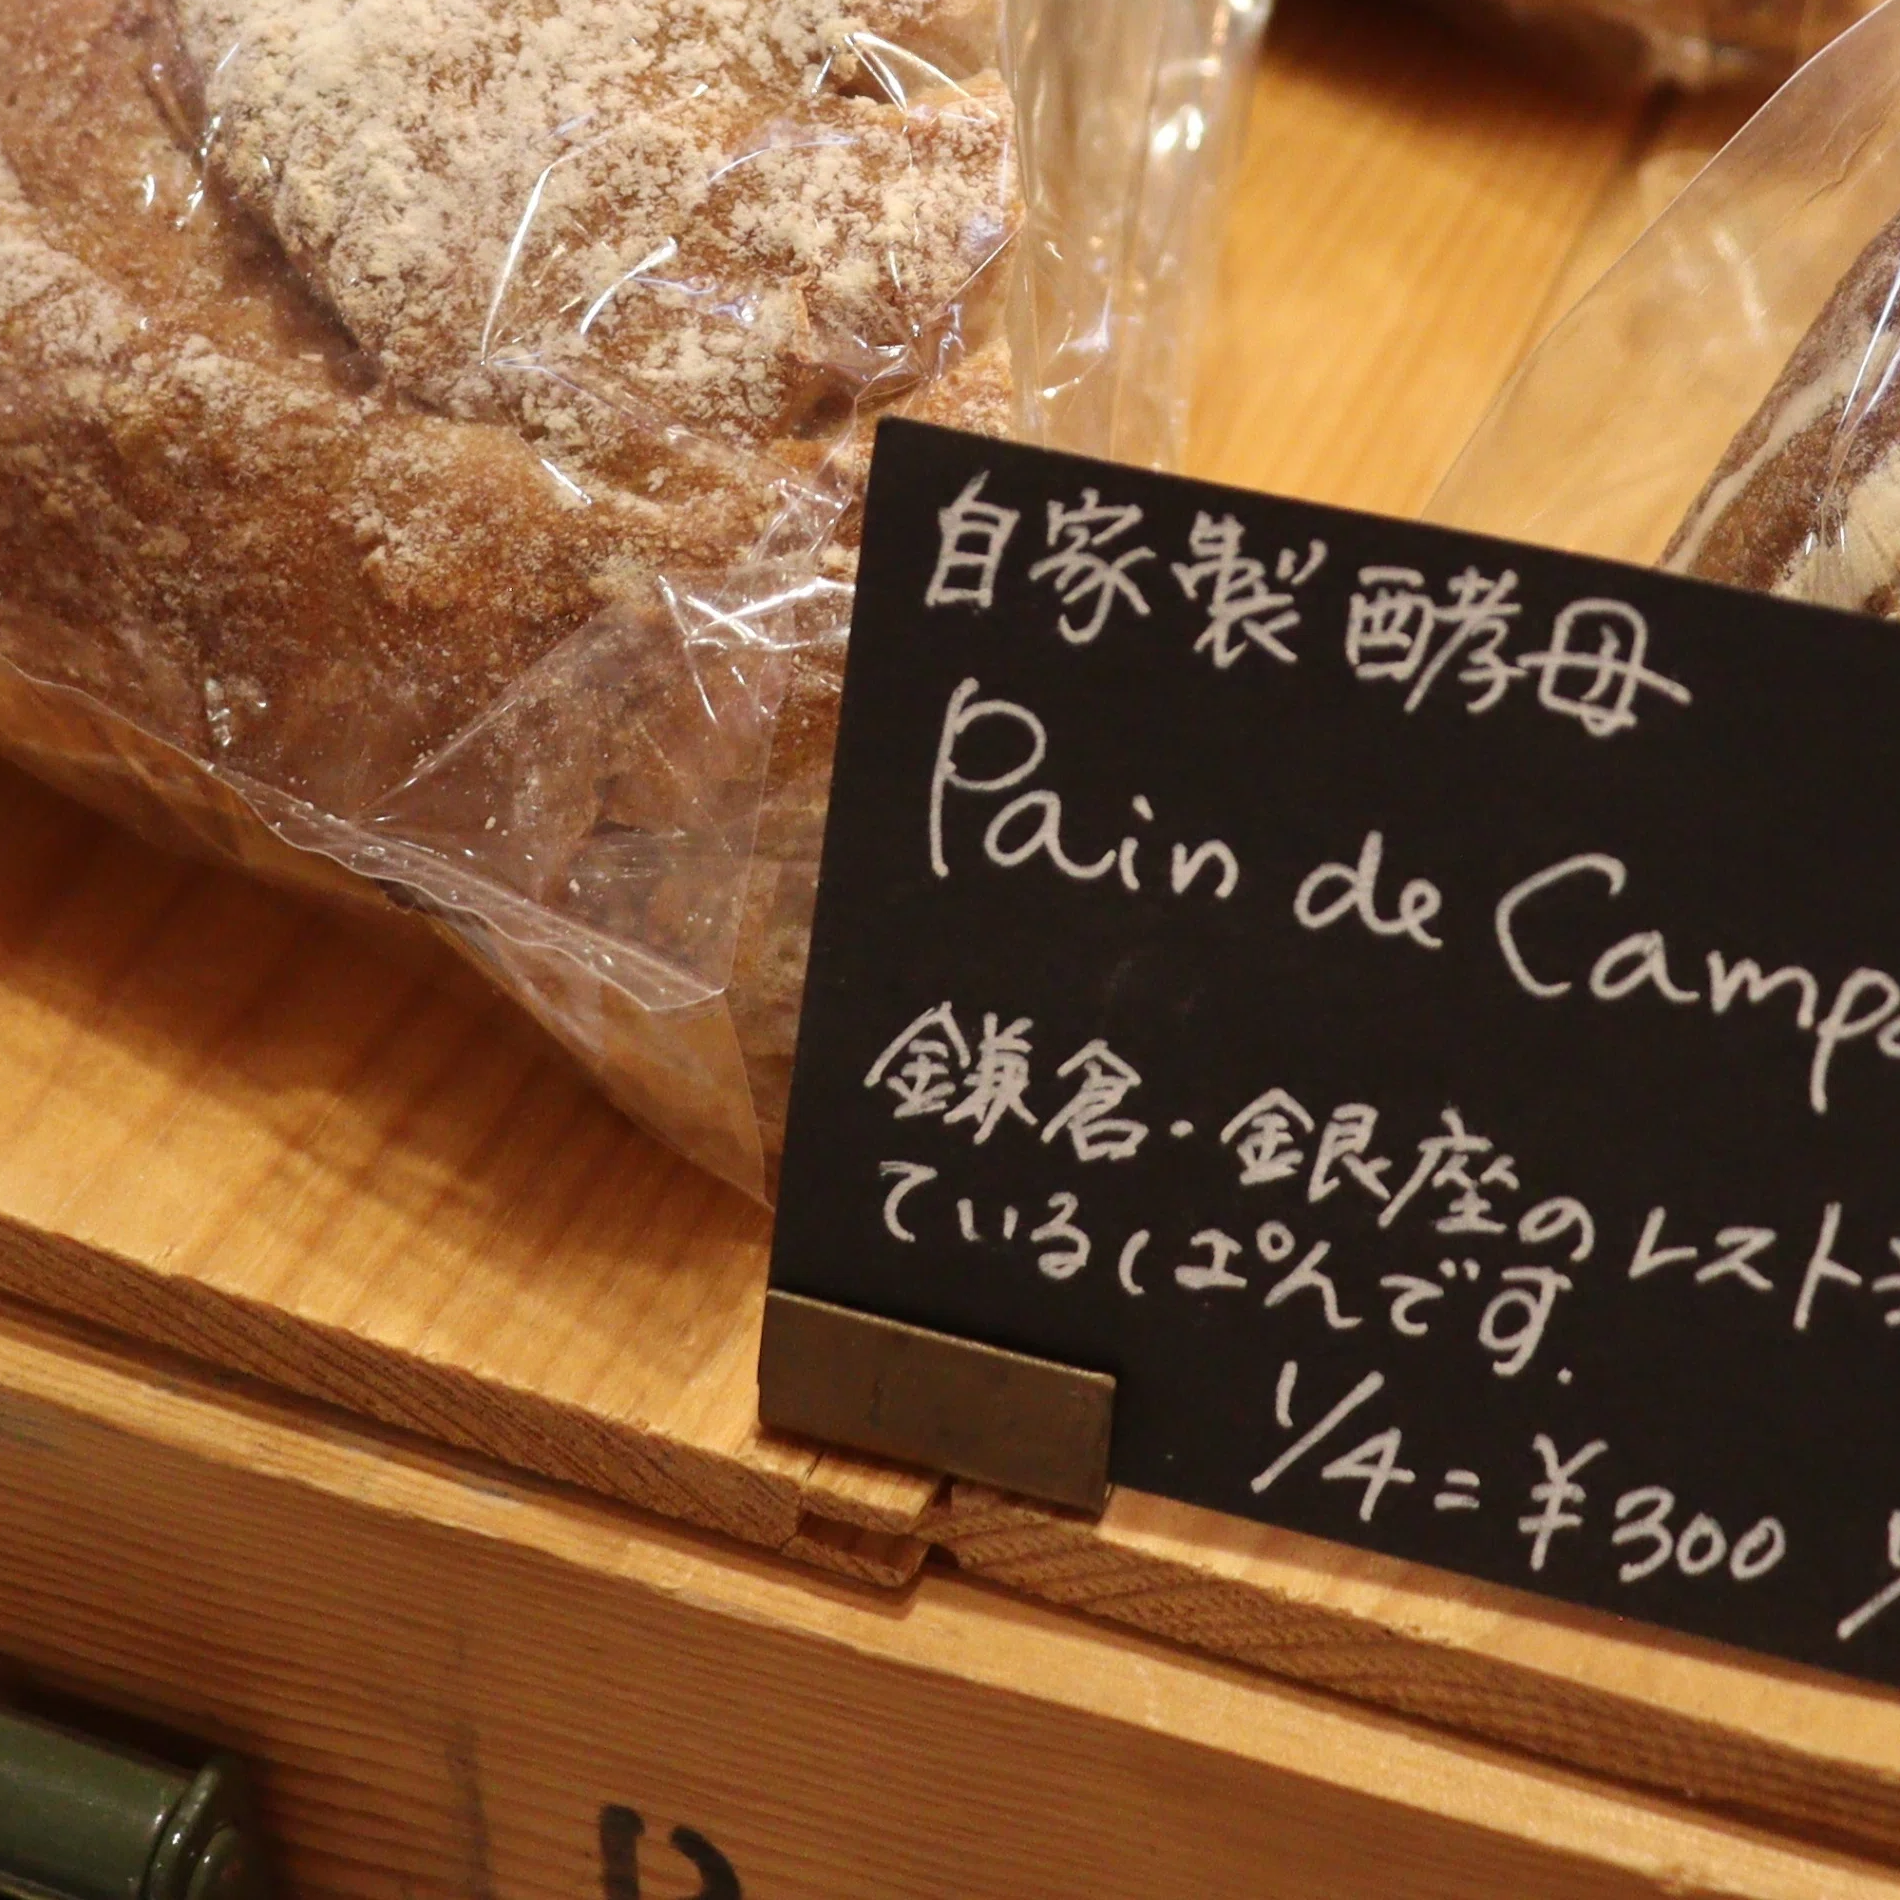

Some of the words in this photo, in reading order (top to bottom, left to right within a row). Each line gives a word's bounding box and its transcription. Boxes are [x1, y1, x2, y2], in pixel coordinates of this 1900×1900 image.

[924, 471, 1693, 736] 自家製酵母
[929, 676, 1242, 878] Pain
[1293, 831, 1443, 950] de
